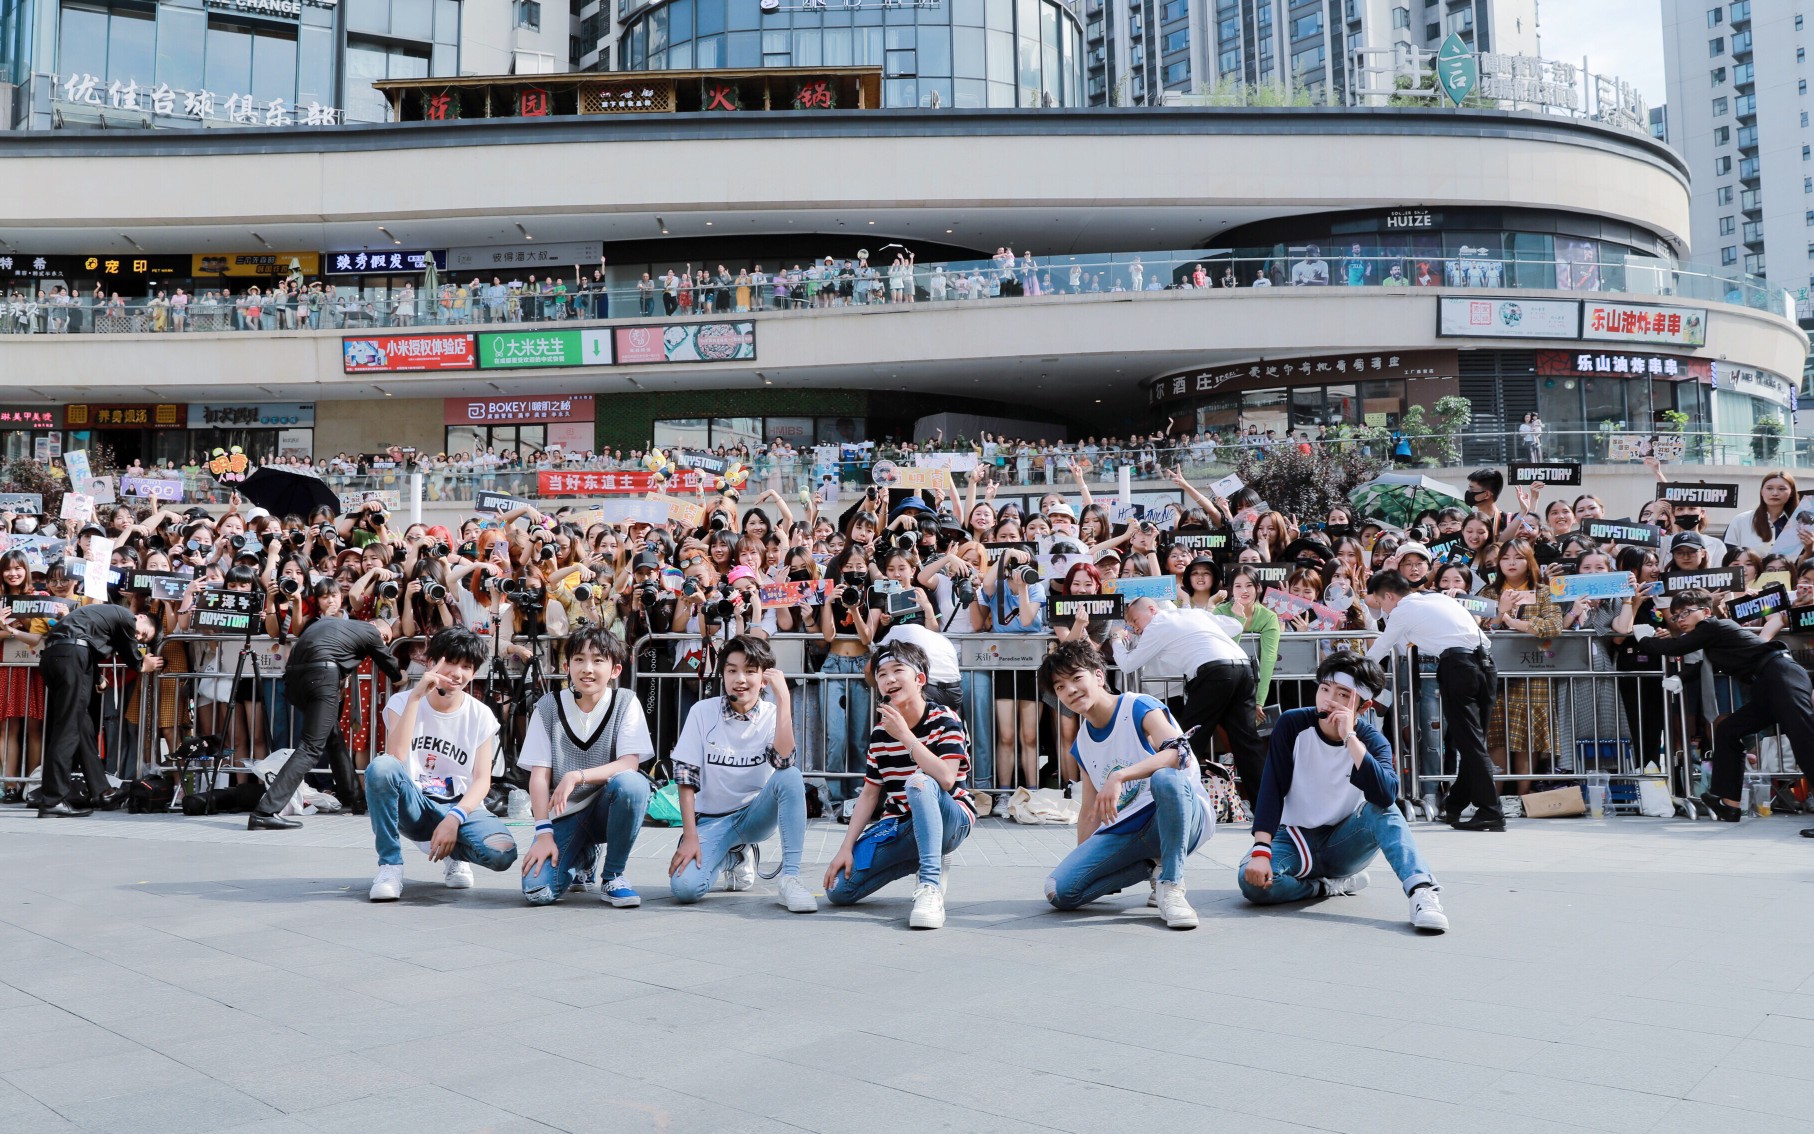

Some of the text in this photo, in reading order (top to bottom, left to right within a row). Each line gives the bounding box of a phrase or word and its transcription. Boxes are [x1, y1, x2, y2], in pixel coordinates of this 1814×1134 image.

[64, 73, 338, 127] 优佳台球俱乐部
[1387, 215, 1432, 228] HUIZE
[104, 259, 149, 274] 宠印
[1591, 308, 1681, 336] 乐山油炸串串
[386, 338, 466, 357] 小米授权体验店
[506, 337, 565, 357] 大米先生
[1577, 354, 1679, 376] 乐山油炸串串
[488, 401, 528, 413] BOKEY
[677, 454, 723, 471] BOYSTORY
[549, 474, 635, 491] 当好东道主
[1517, 467, 1572, 481] BOYSTORY
[1665, 488, 1728, 503] BOYSTORY
[1590, 523, 1651, 541] BOYSTORY
[1668, 573, 1733, 591] BOYSTORY
[12, 600, 59, 614] BOYSTOR
[1735, 592, 1781, 619] BOYSTORY
[975, 652, 991, 662] 天街
[1520, 651, 1544, 665] 天街
